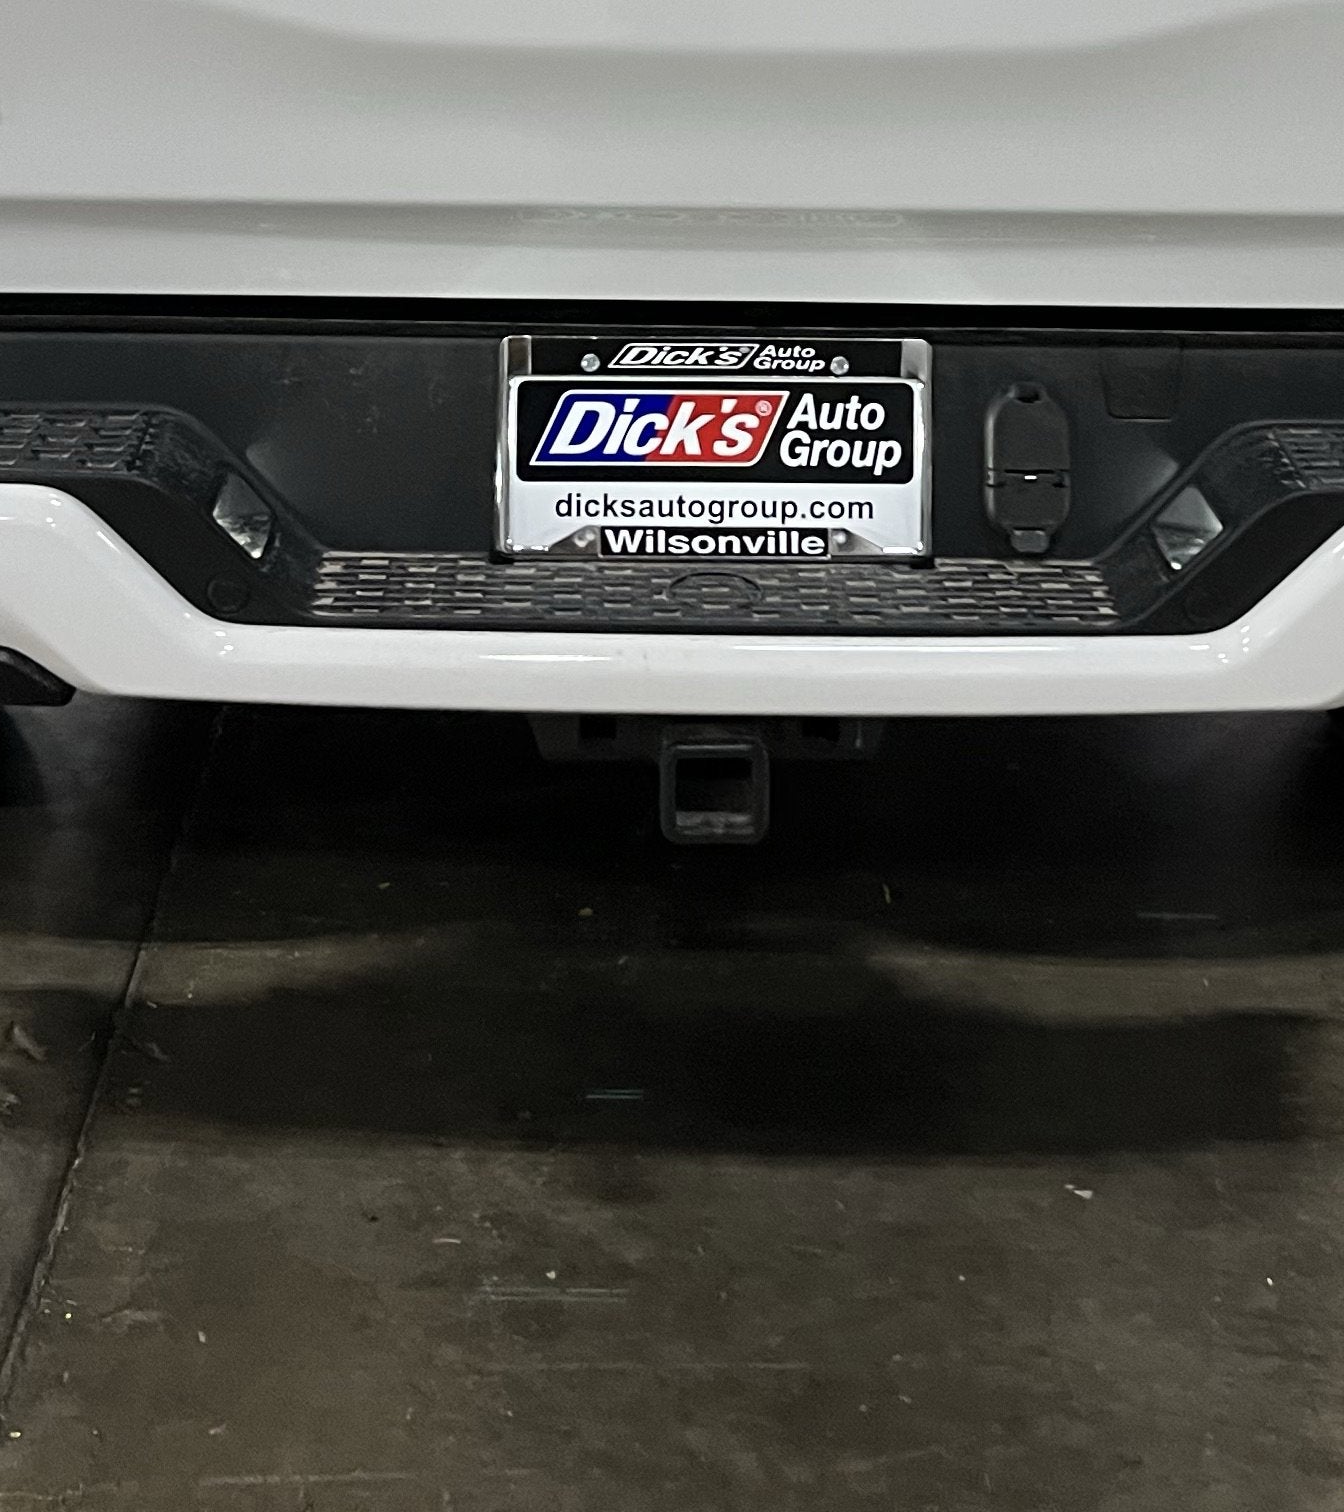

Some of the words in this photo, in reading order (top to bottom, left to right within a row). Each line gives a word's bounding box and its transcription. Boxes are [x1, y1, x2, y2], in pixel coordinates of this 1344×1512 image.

[620, 345, 742, 366] Dick's
[754, 357, 826, 372] Group
[759, 344, 816, 358] Auto
[787, 392, 885, 430] Auto
[548, 398, 759, 456] Dick's
[779, 430, 902, 476] Group
[555, 492, 875, 524] dicksautogroup.com
[604, 529, 826, 555] Wilsonville
